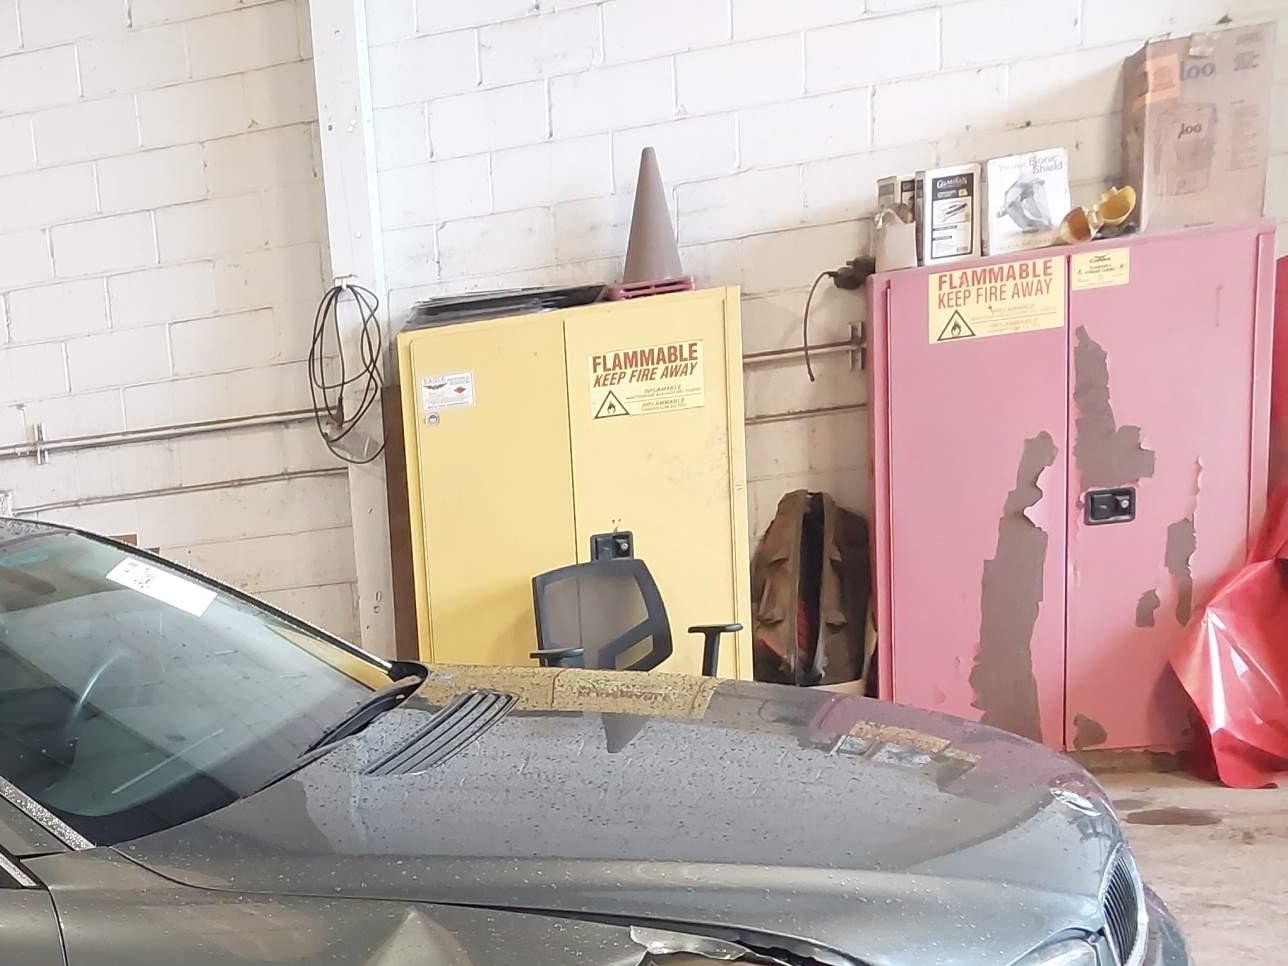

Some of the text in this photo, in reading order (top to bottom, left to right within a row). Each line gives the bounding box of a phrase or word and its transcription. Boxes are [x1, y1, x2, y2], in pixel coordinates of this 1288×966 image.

[938, 259, 1053, 291] FLAMMABLE
[938, 291, 971, 309] KEEP
[976, 286, 1007, 304] FIRE
[1012, 278, 1053, 299] AWAY
[592, 342, 698, 373] FLAMMABLE
[594, 361, 698, 388] KEEP FIRE AWAY
